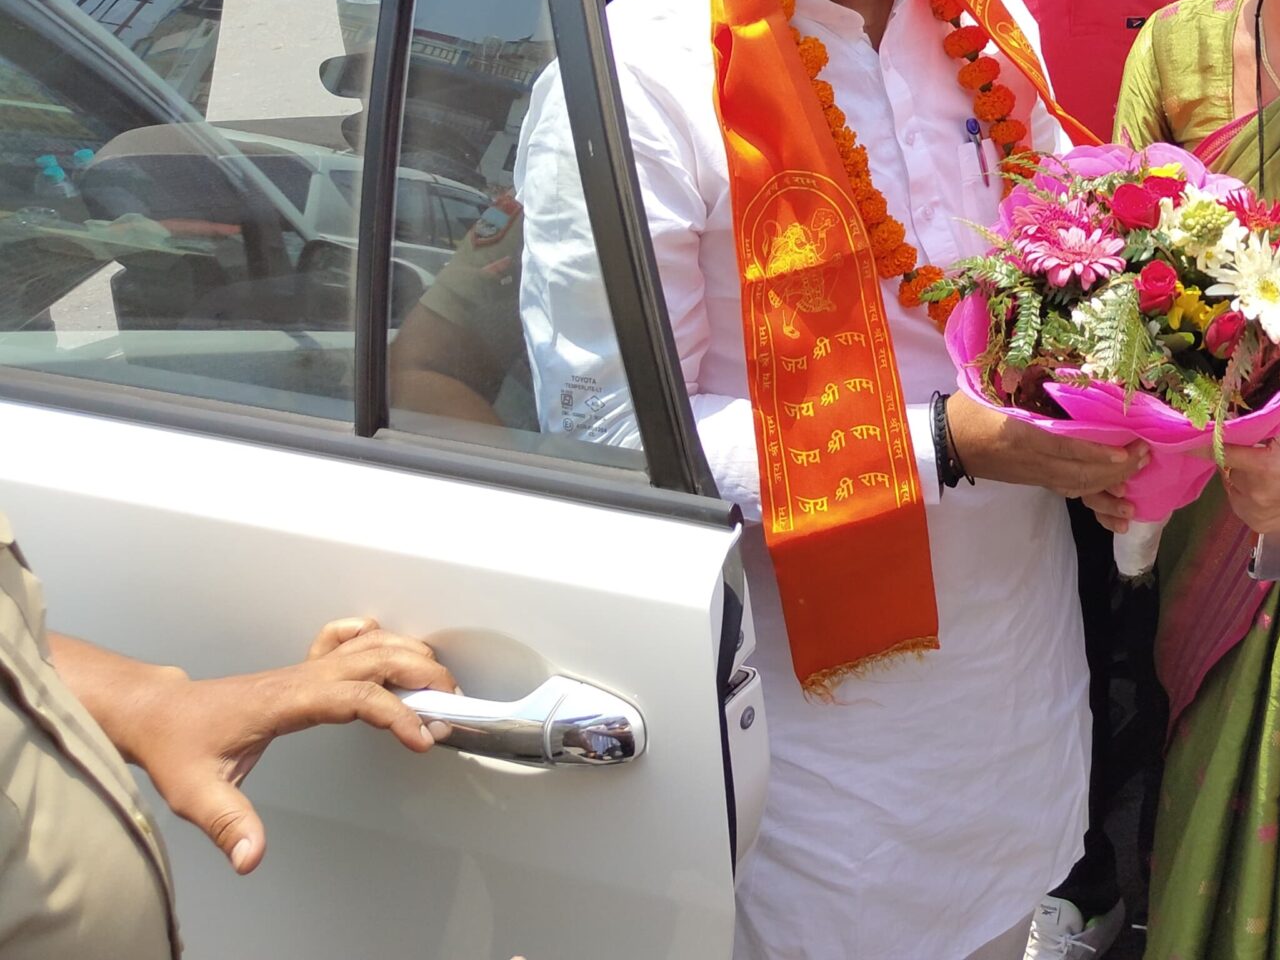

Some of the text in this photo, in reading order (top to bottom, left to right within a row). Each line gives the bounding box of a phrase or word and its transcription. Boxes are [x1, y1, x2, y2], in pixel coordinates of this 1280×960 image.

[781, 331, 866, 374] जय श्री राम
[783, 378, 874, 419] जय श्री राम
[788, 424, 881, 466] जय श्री राम
[795, 472, 890, 515] जय श्री राम
